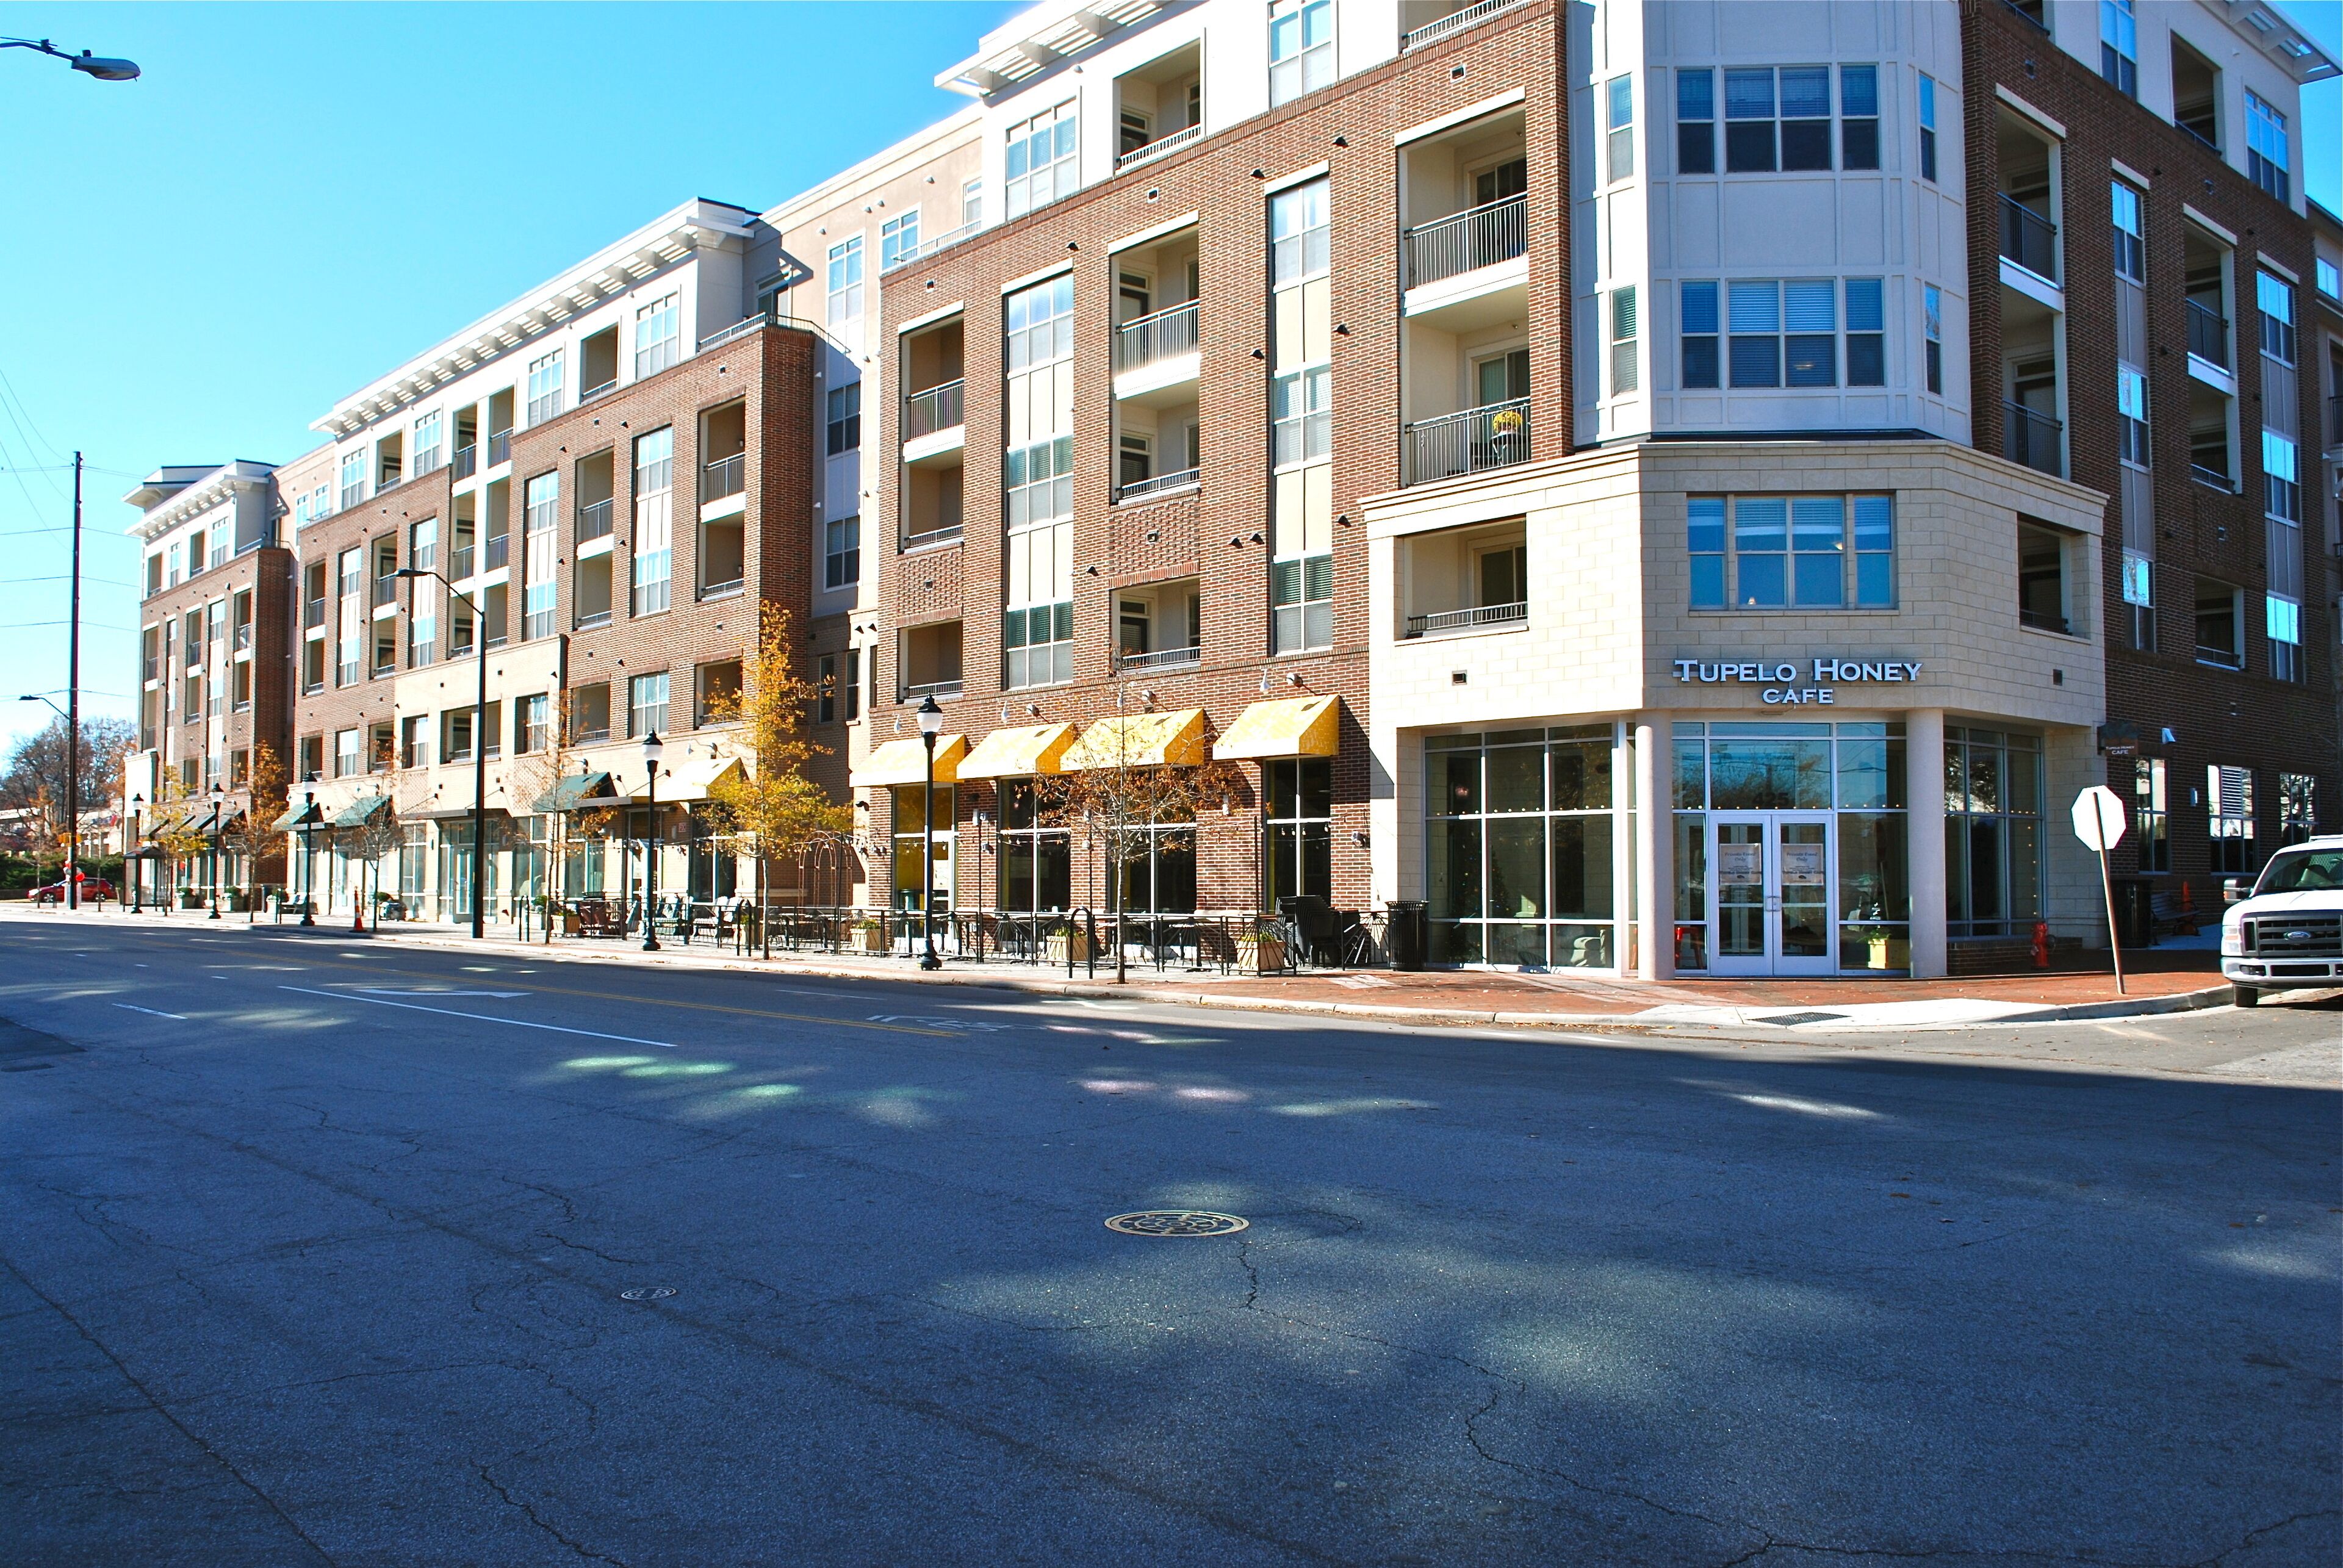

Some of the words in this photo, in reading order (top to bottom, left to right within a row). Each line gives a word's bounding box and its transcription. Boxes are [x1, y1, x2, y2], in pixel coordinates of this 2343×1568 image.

[1674, 659, 1797, 682] TUPELO
[1813, 658, 1923, 682] HONEY
[1762, 688, 1834, 704] CAFE
[1752, 792, 1790, 807] 425
